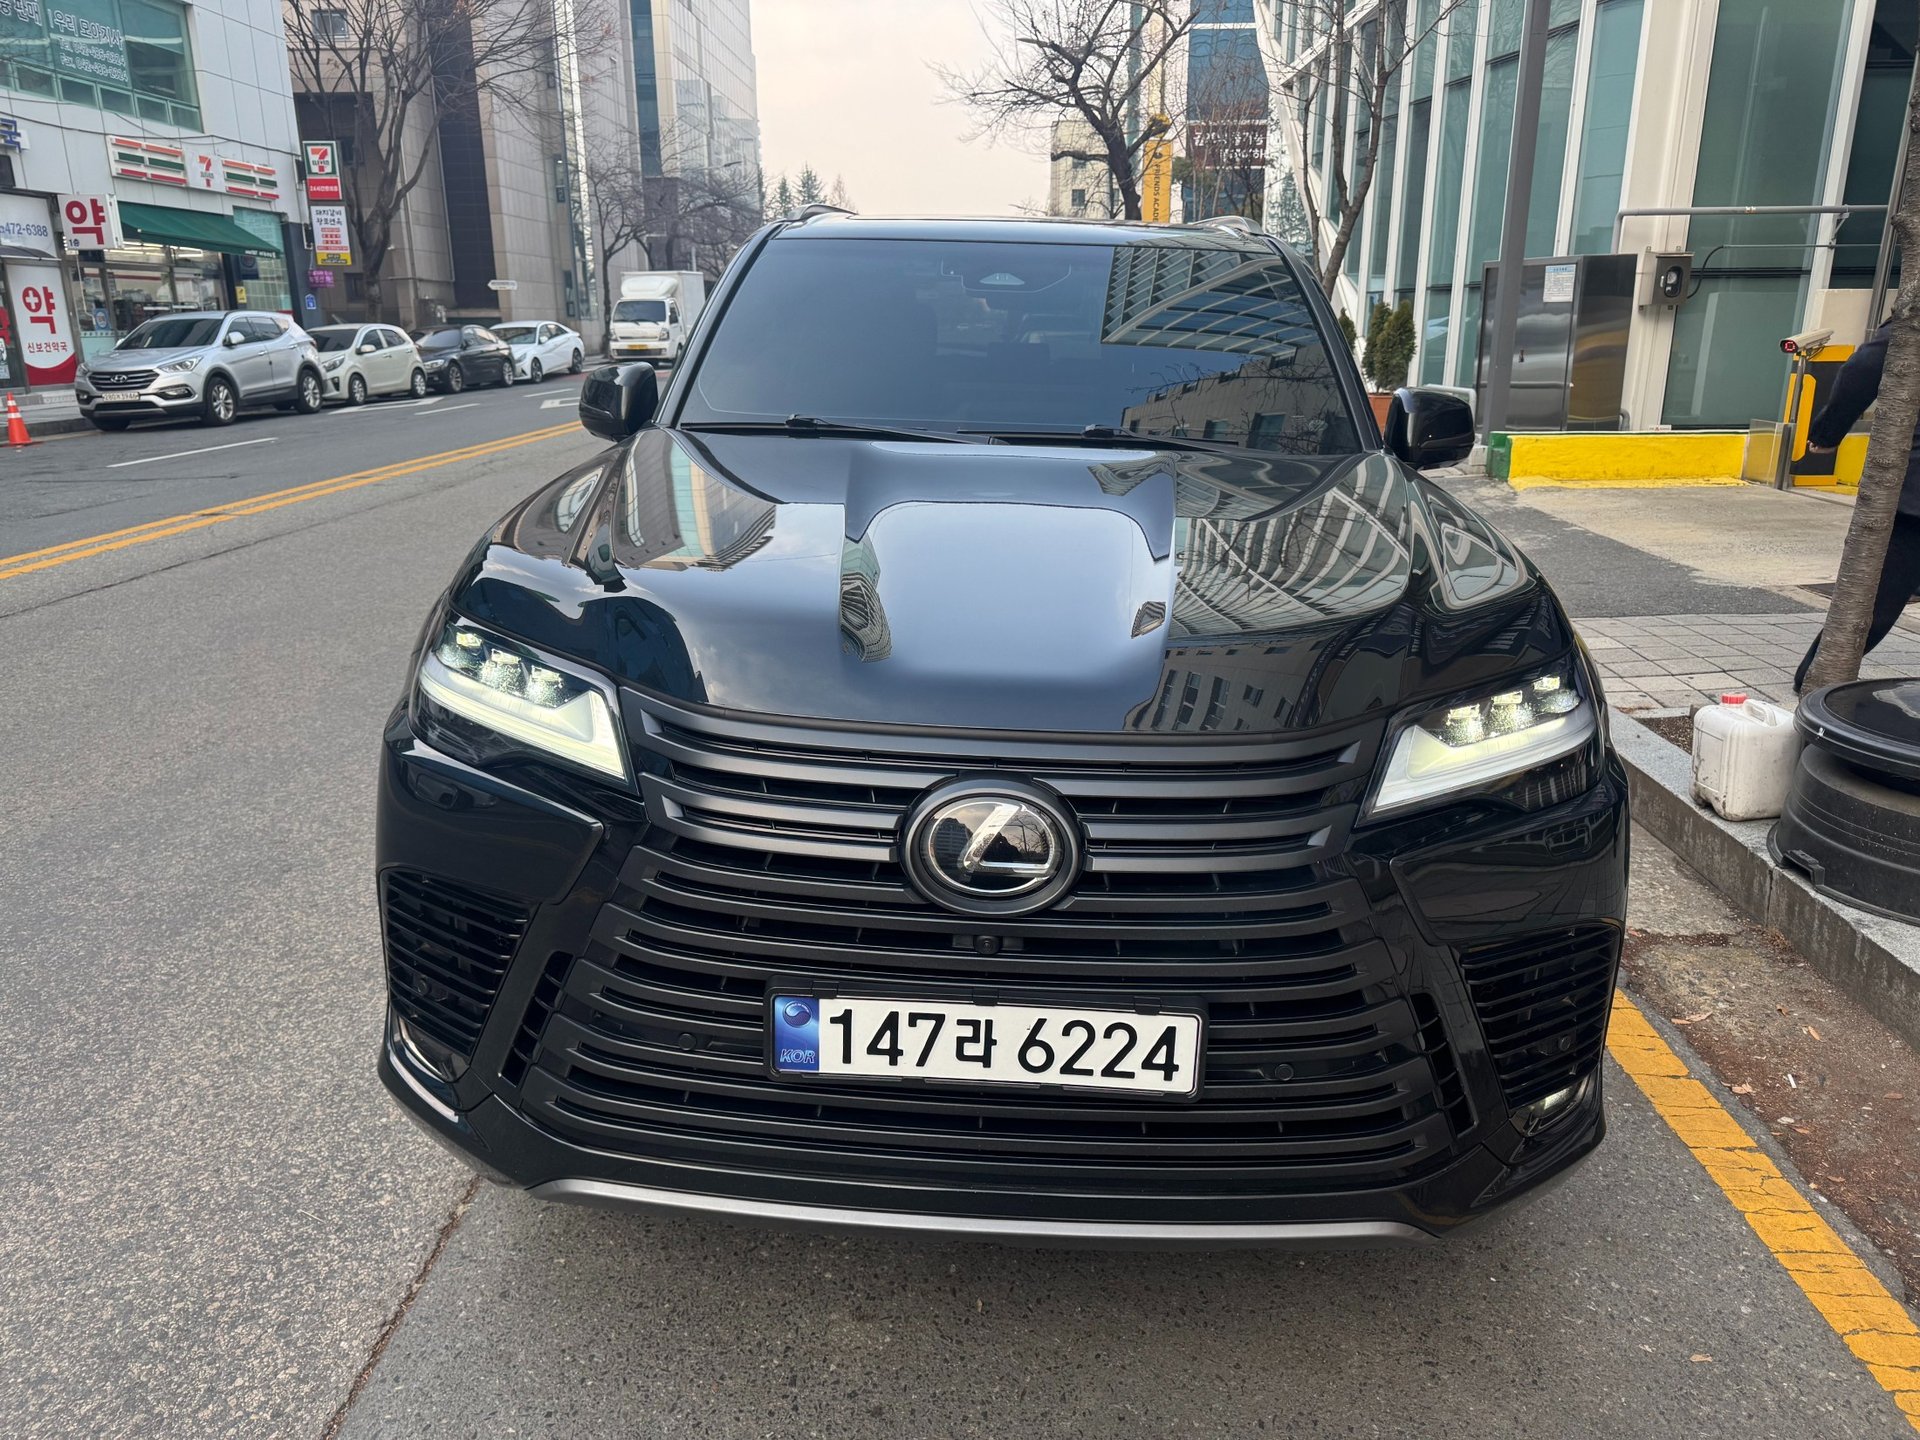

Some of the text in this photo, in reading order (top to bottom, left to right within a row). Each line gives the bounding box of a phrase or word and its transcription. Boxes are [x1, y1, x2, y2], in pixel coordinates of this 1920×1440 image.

[54, 10, 79, 37] 우리
[1153, 164, 1161, 196] FRIENDS
[5, 222, 48, 237] 472-6388
[65, 198, 106, 245] 약
[22, 286, 56, 334] 약
[28, 341, 68, 353] 신보건약국
[780, 1048, 815, 1064] KOR
[829, 1008, 1179, 1081] 147라 6224
